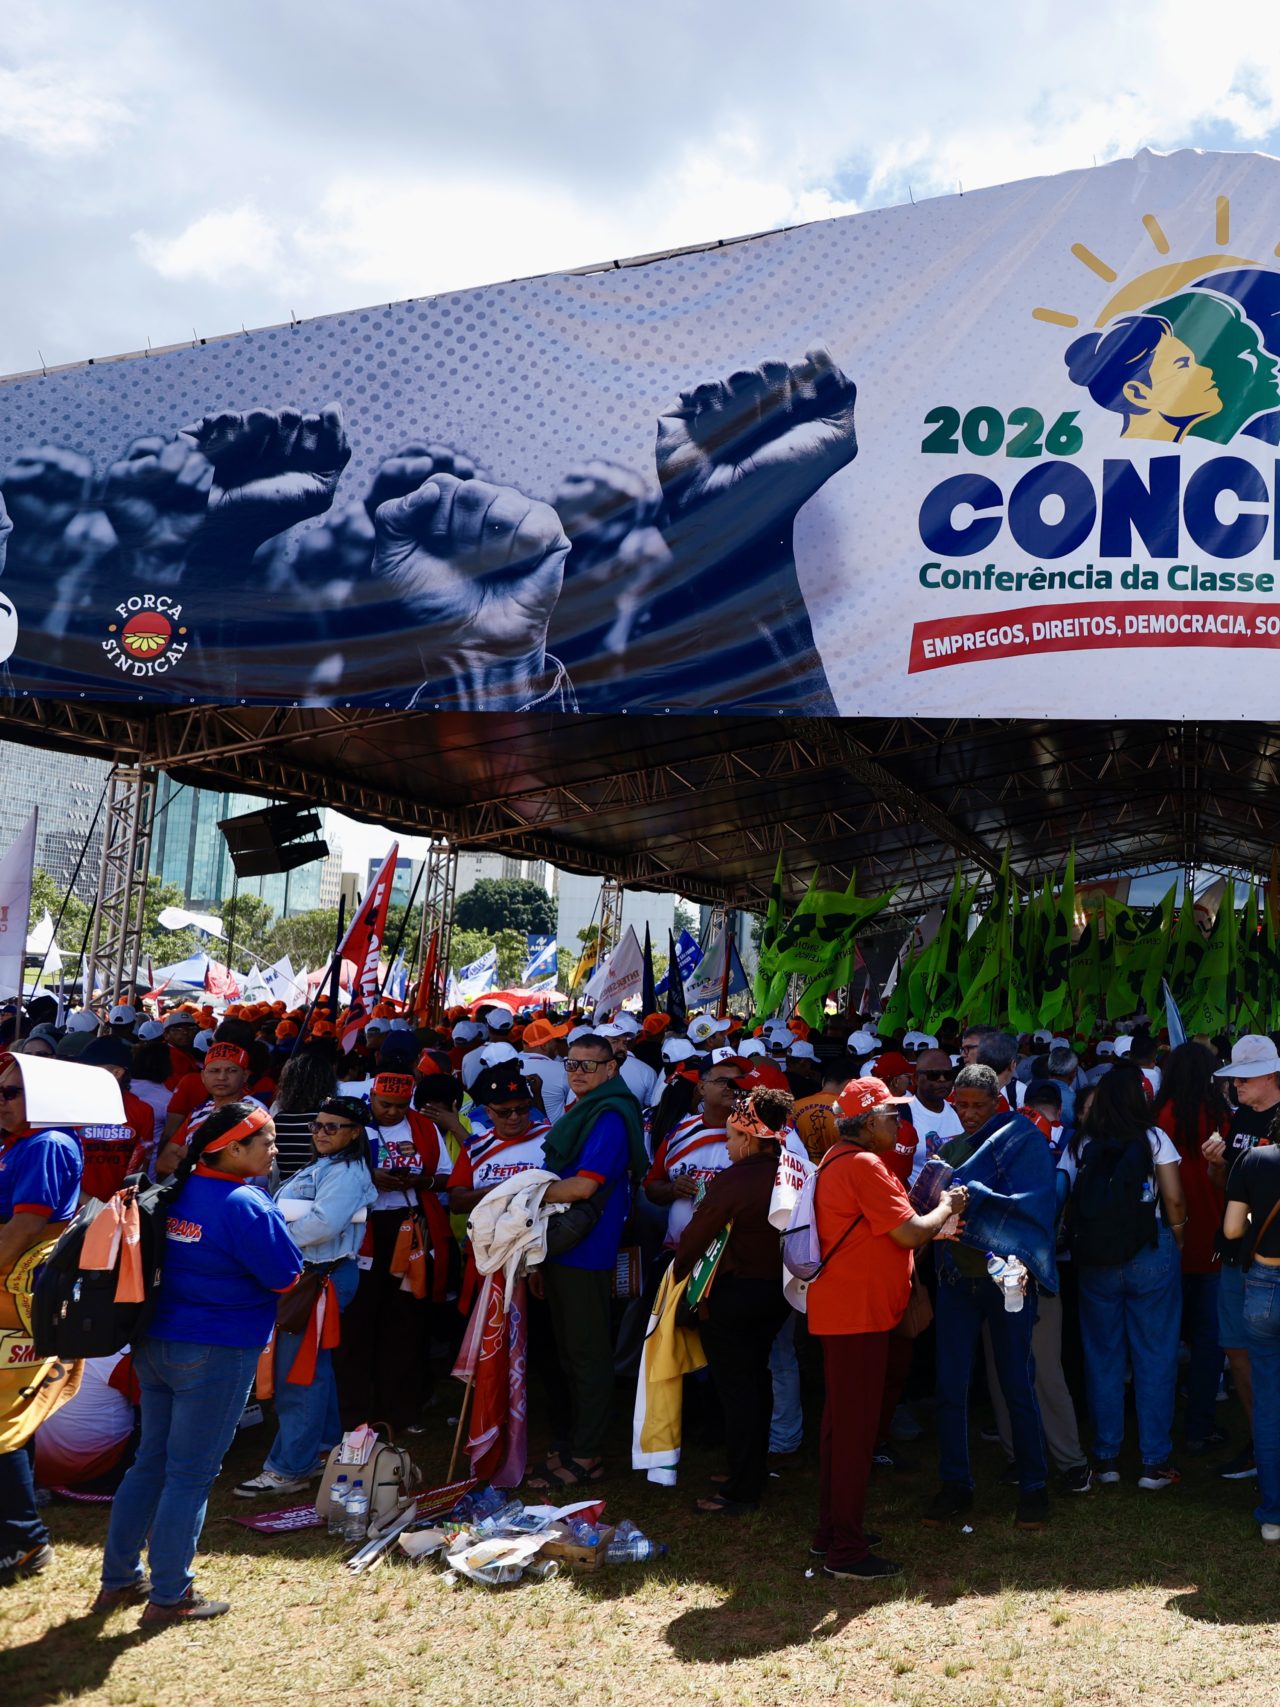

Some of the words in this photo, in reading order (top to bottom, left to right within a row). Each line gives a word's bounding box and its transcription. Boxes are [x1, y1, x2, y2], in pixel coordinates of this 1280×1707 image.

[921, 405, 1083, 458] 2026
[919, 562, 1112, 591] Conferência
[1120, 563, 1158, 591] da
[1167, 564, 1275, 592] Classe
[115, 594, 183, 621] FORÇA
[922, 624, 1030, 659] EMPREGOS,
[1032, 616, 1122, 641] DIREITOS,
[1124, 614, 1251, 637] DEMOCRACIA,
[102, 639, 188, 677] SINDICAL
